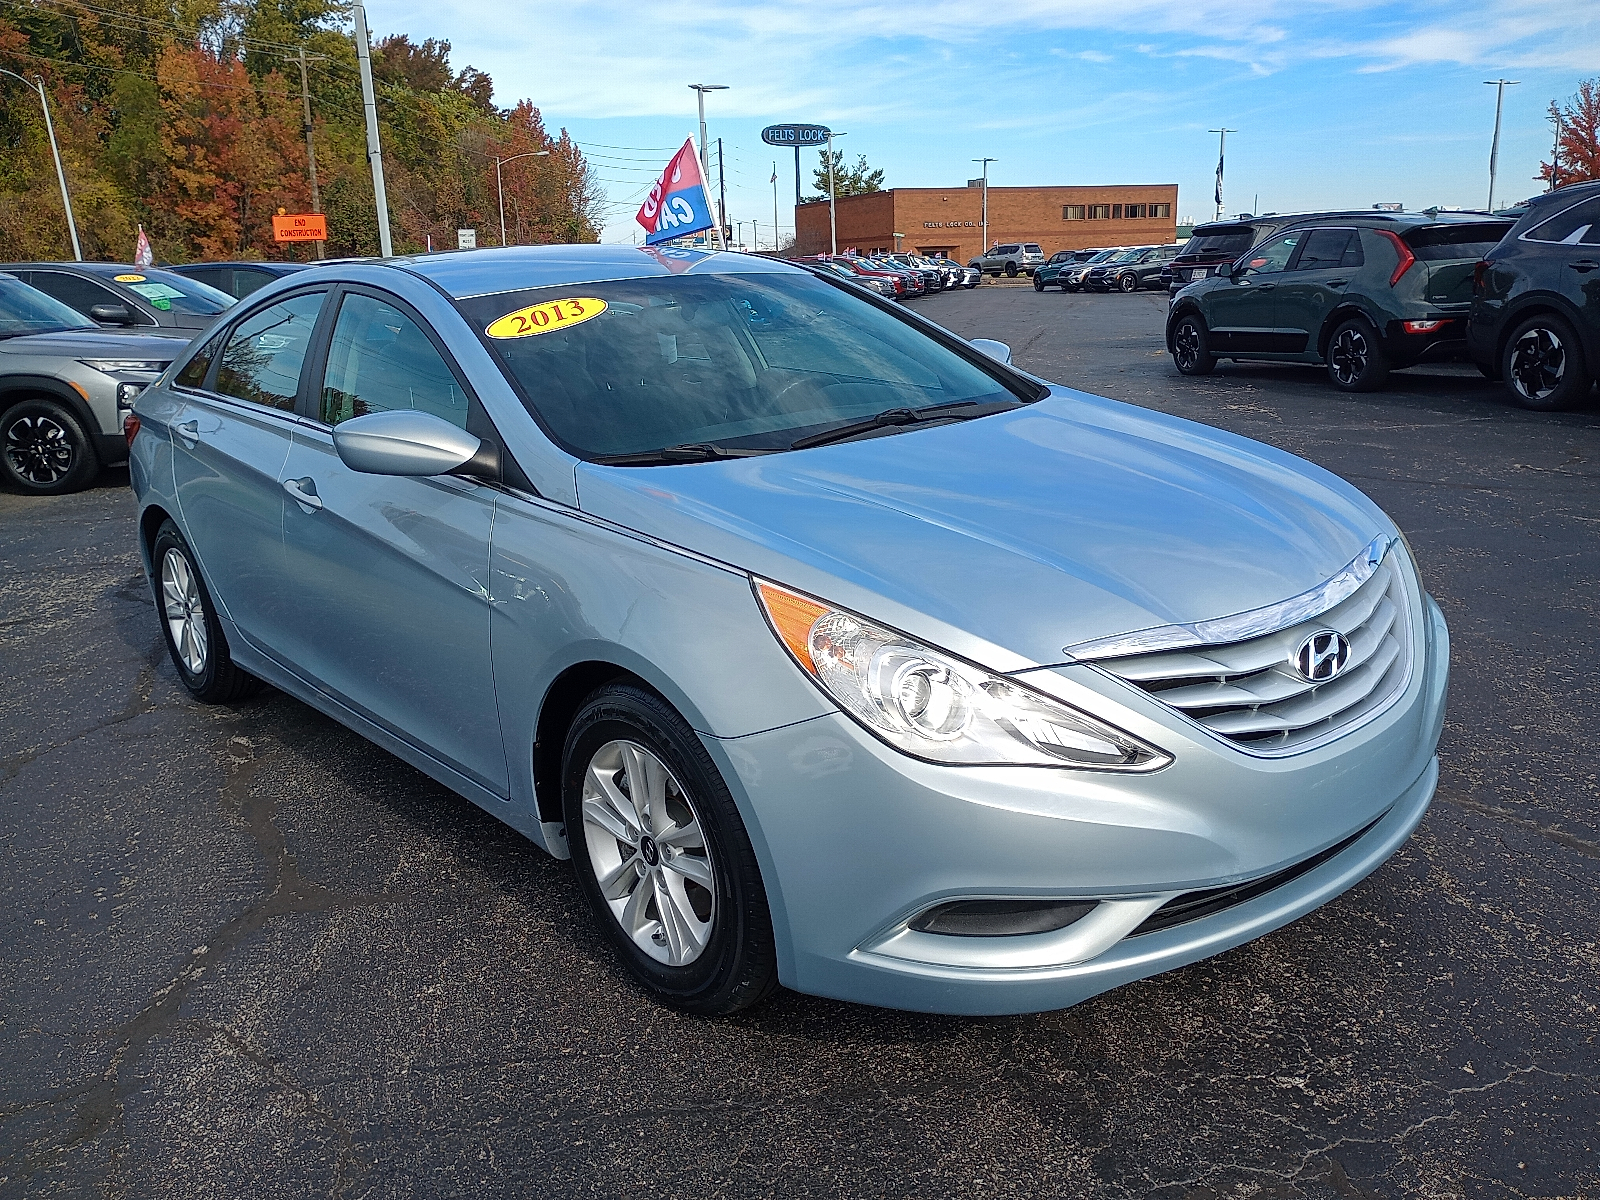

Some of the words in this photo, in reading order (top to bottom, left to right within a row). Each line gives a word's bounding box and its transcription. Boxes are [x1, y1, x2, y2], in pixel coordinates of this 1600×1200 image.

[768, 129, 795, 141] FELTS
[799, 129, 825, 141] LOCK
[294, 218, 306, 227] END
[280, 228, 322, 238] CONSTRUCTION
[510, 300, 585, 334] 2013
